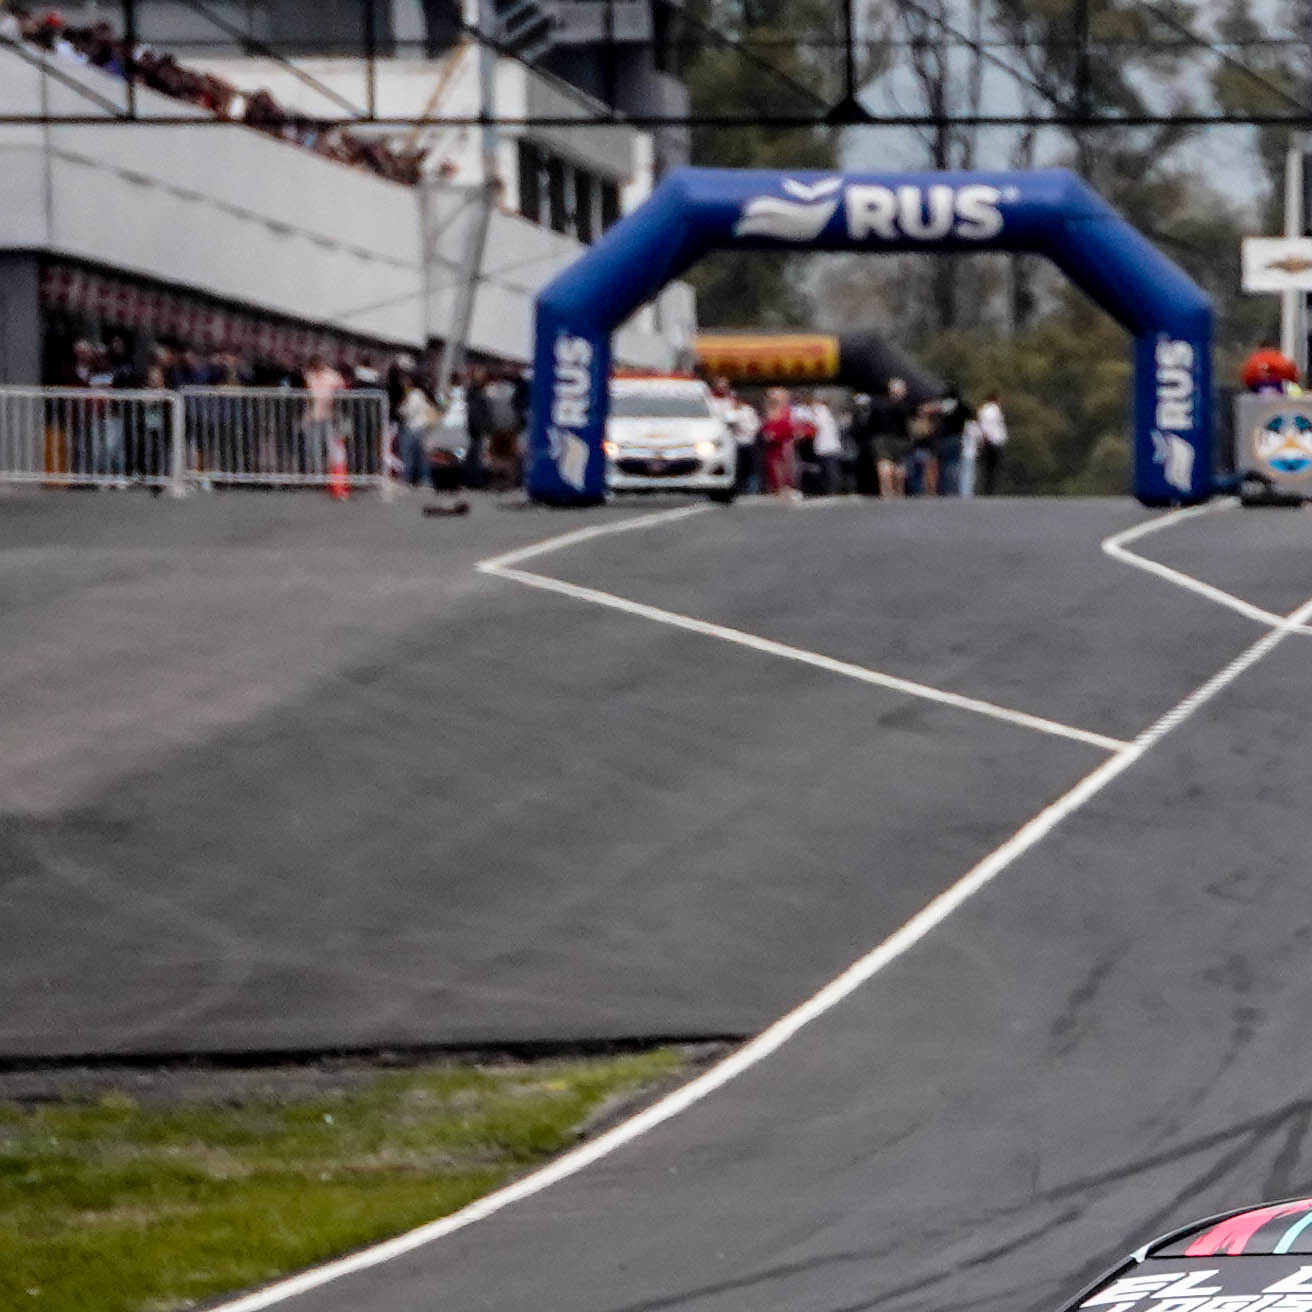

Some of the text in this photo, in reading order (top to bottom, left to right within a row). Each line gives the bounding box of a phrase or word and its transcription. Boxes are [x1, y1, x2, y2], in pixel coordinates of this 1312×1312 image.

[846, 184, 1005, 241] RUS
[555, 335, 593, 429] RUS
[1157, 339, 1194, 431] RUS
[1084, 1269, 1223, 1303] EL
